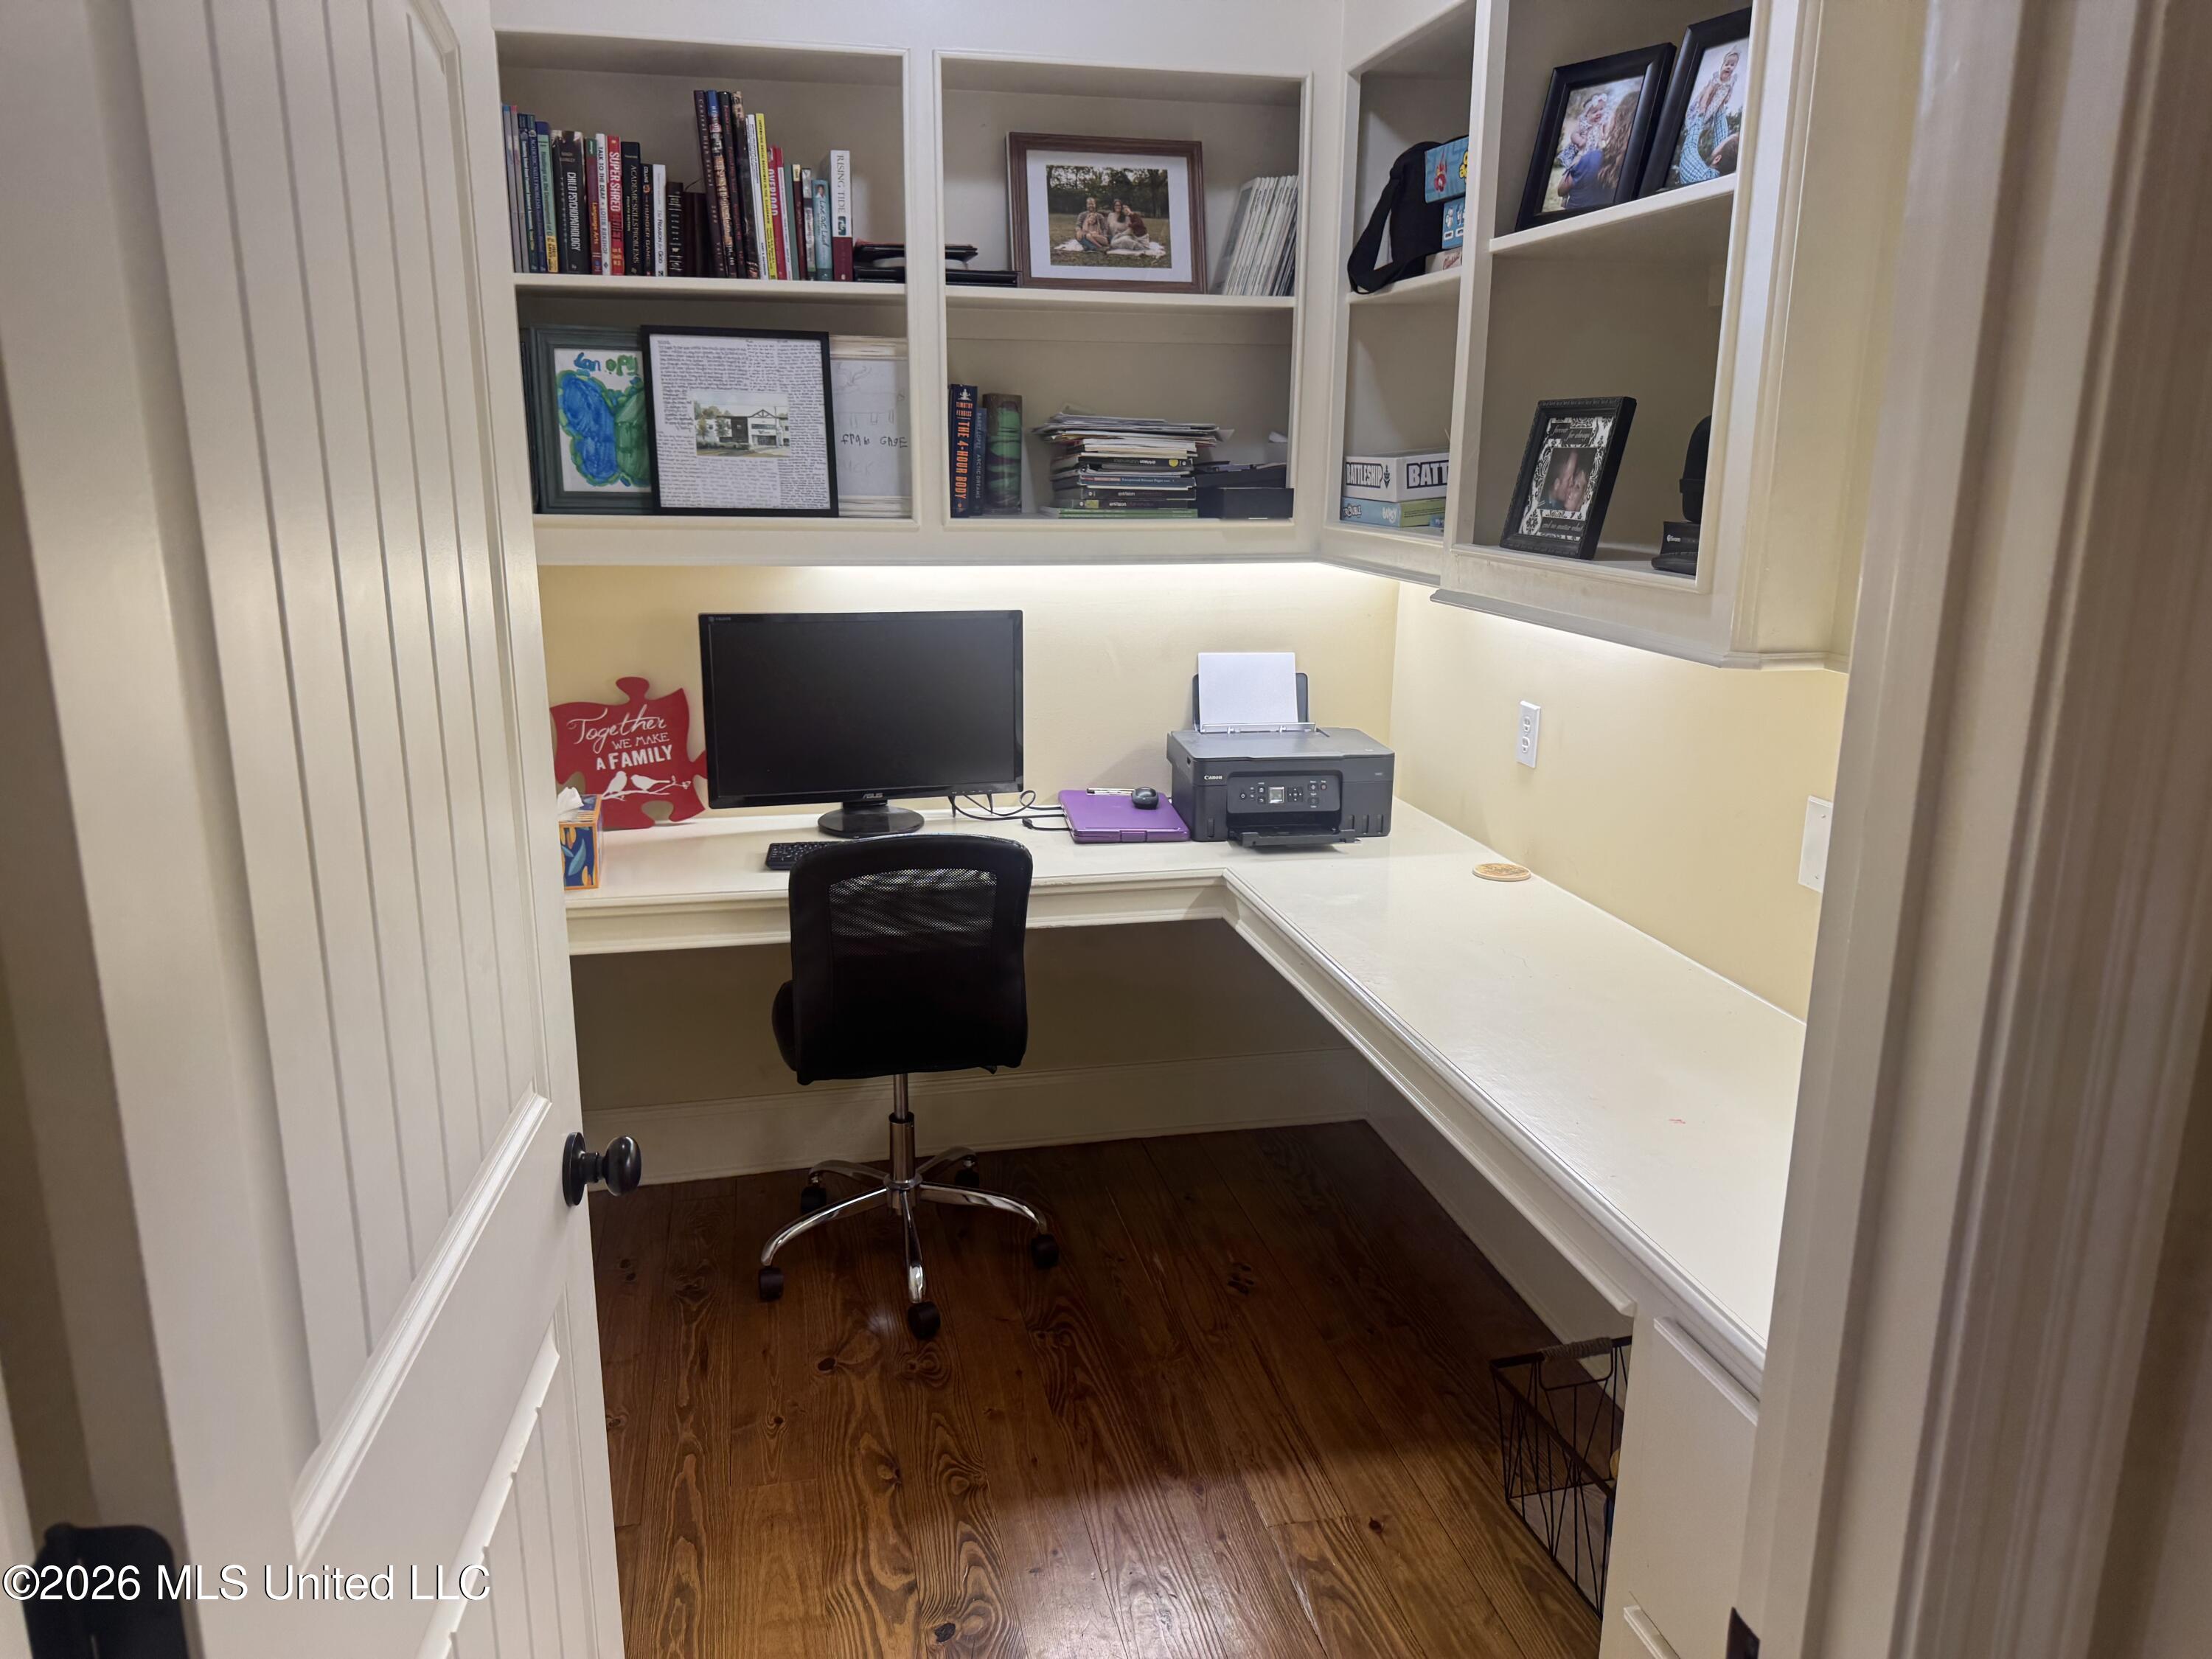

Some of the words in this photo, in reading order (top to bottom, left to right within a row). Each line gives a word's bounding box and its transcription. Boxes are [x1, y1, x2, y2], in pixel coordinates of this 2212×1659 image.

[599, 162, 605, 171] TO
[609, 151, 620, 181] SUPER
[836, 155, 845, 188] RISING
[566, 172, 577, 191] CHILD
[610, 182, 622, 212] SHRED
[838, 190, 846, 214] TIDE
[568, 192, 581, 251] PSYCHOPATHOLOGY
[632, 227, 640, 264] PROBLEMS
[956, 401, 973, 409] TIMOTHY
[958, 422, 970, 438] THE
[956, 440, 969, 473] 4-HOUR
[955, 476, 967, 499] BODY
[1346, 462, 1383, 488] BATTLESHIP
[566, 703, 667, 754] Together
[612, 739, 632, 750] WE
[635, 732, 670, 746] MAKE
[597, 757, 606, 770] A
[608, 744, 672, 770] FAMILY
